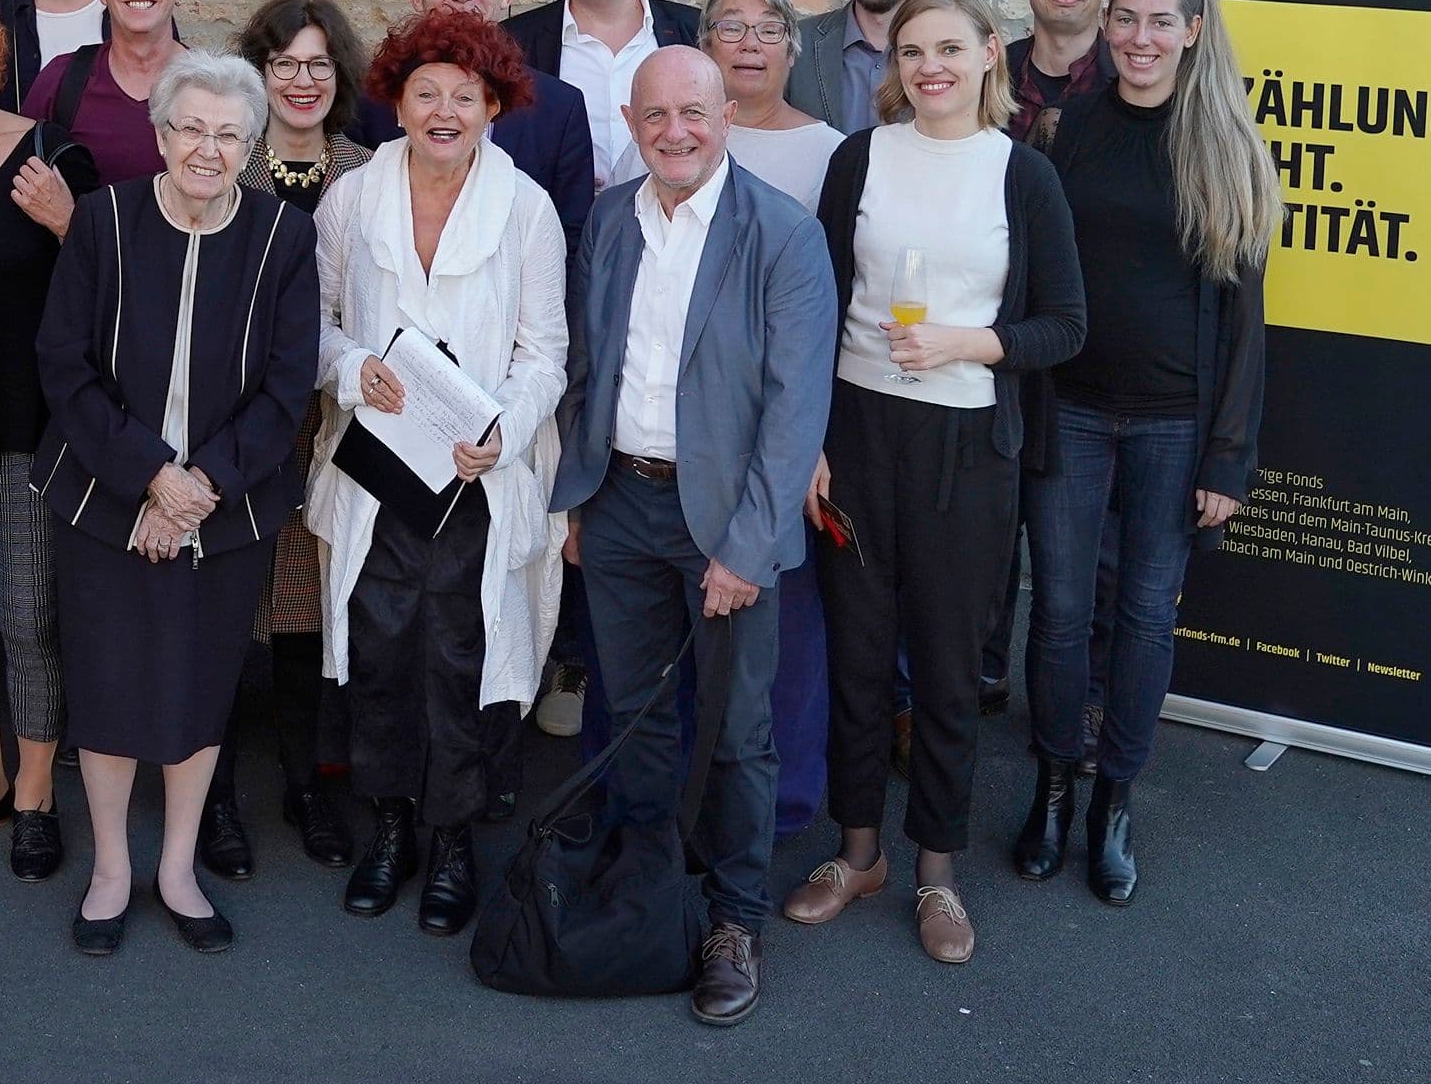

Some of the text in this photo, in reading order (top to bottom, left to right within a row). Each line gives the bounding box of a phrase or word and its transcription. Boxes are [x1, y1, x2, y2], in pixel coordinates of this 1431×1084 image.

[1263, 140, 1344, 193] HT.
[1286, 472, 1324, 490] Fonds
[1248, 487, 1411, 525] essen, Frankfurt am Main,
[1272, 510, 1296, 525] und
[1299, 512, 1327, 529] dem
[1218, 539, 1259, 557] nbach
[1261, 546, 1282, 561] am
[1285, 549, 1316, 566] Main
[1318, 555, 1343, 571] und
[1229, 521, 1413, 564] Wiesbaden, Hanau, Bad Vilbel,
[1256, 641, 1301, 659] Facebook
[1315, 652, 1351, 668] Twitter
[1367, 661, 1422, 681] Newsletter
